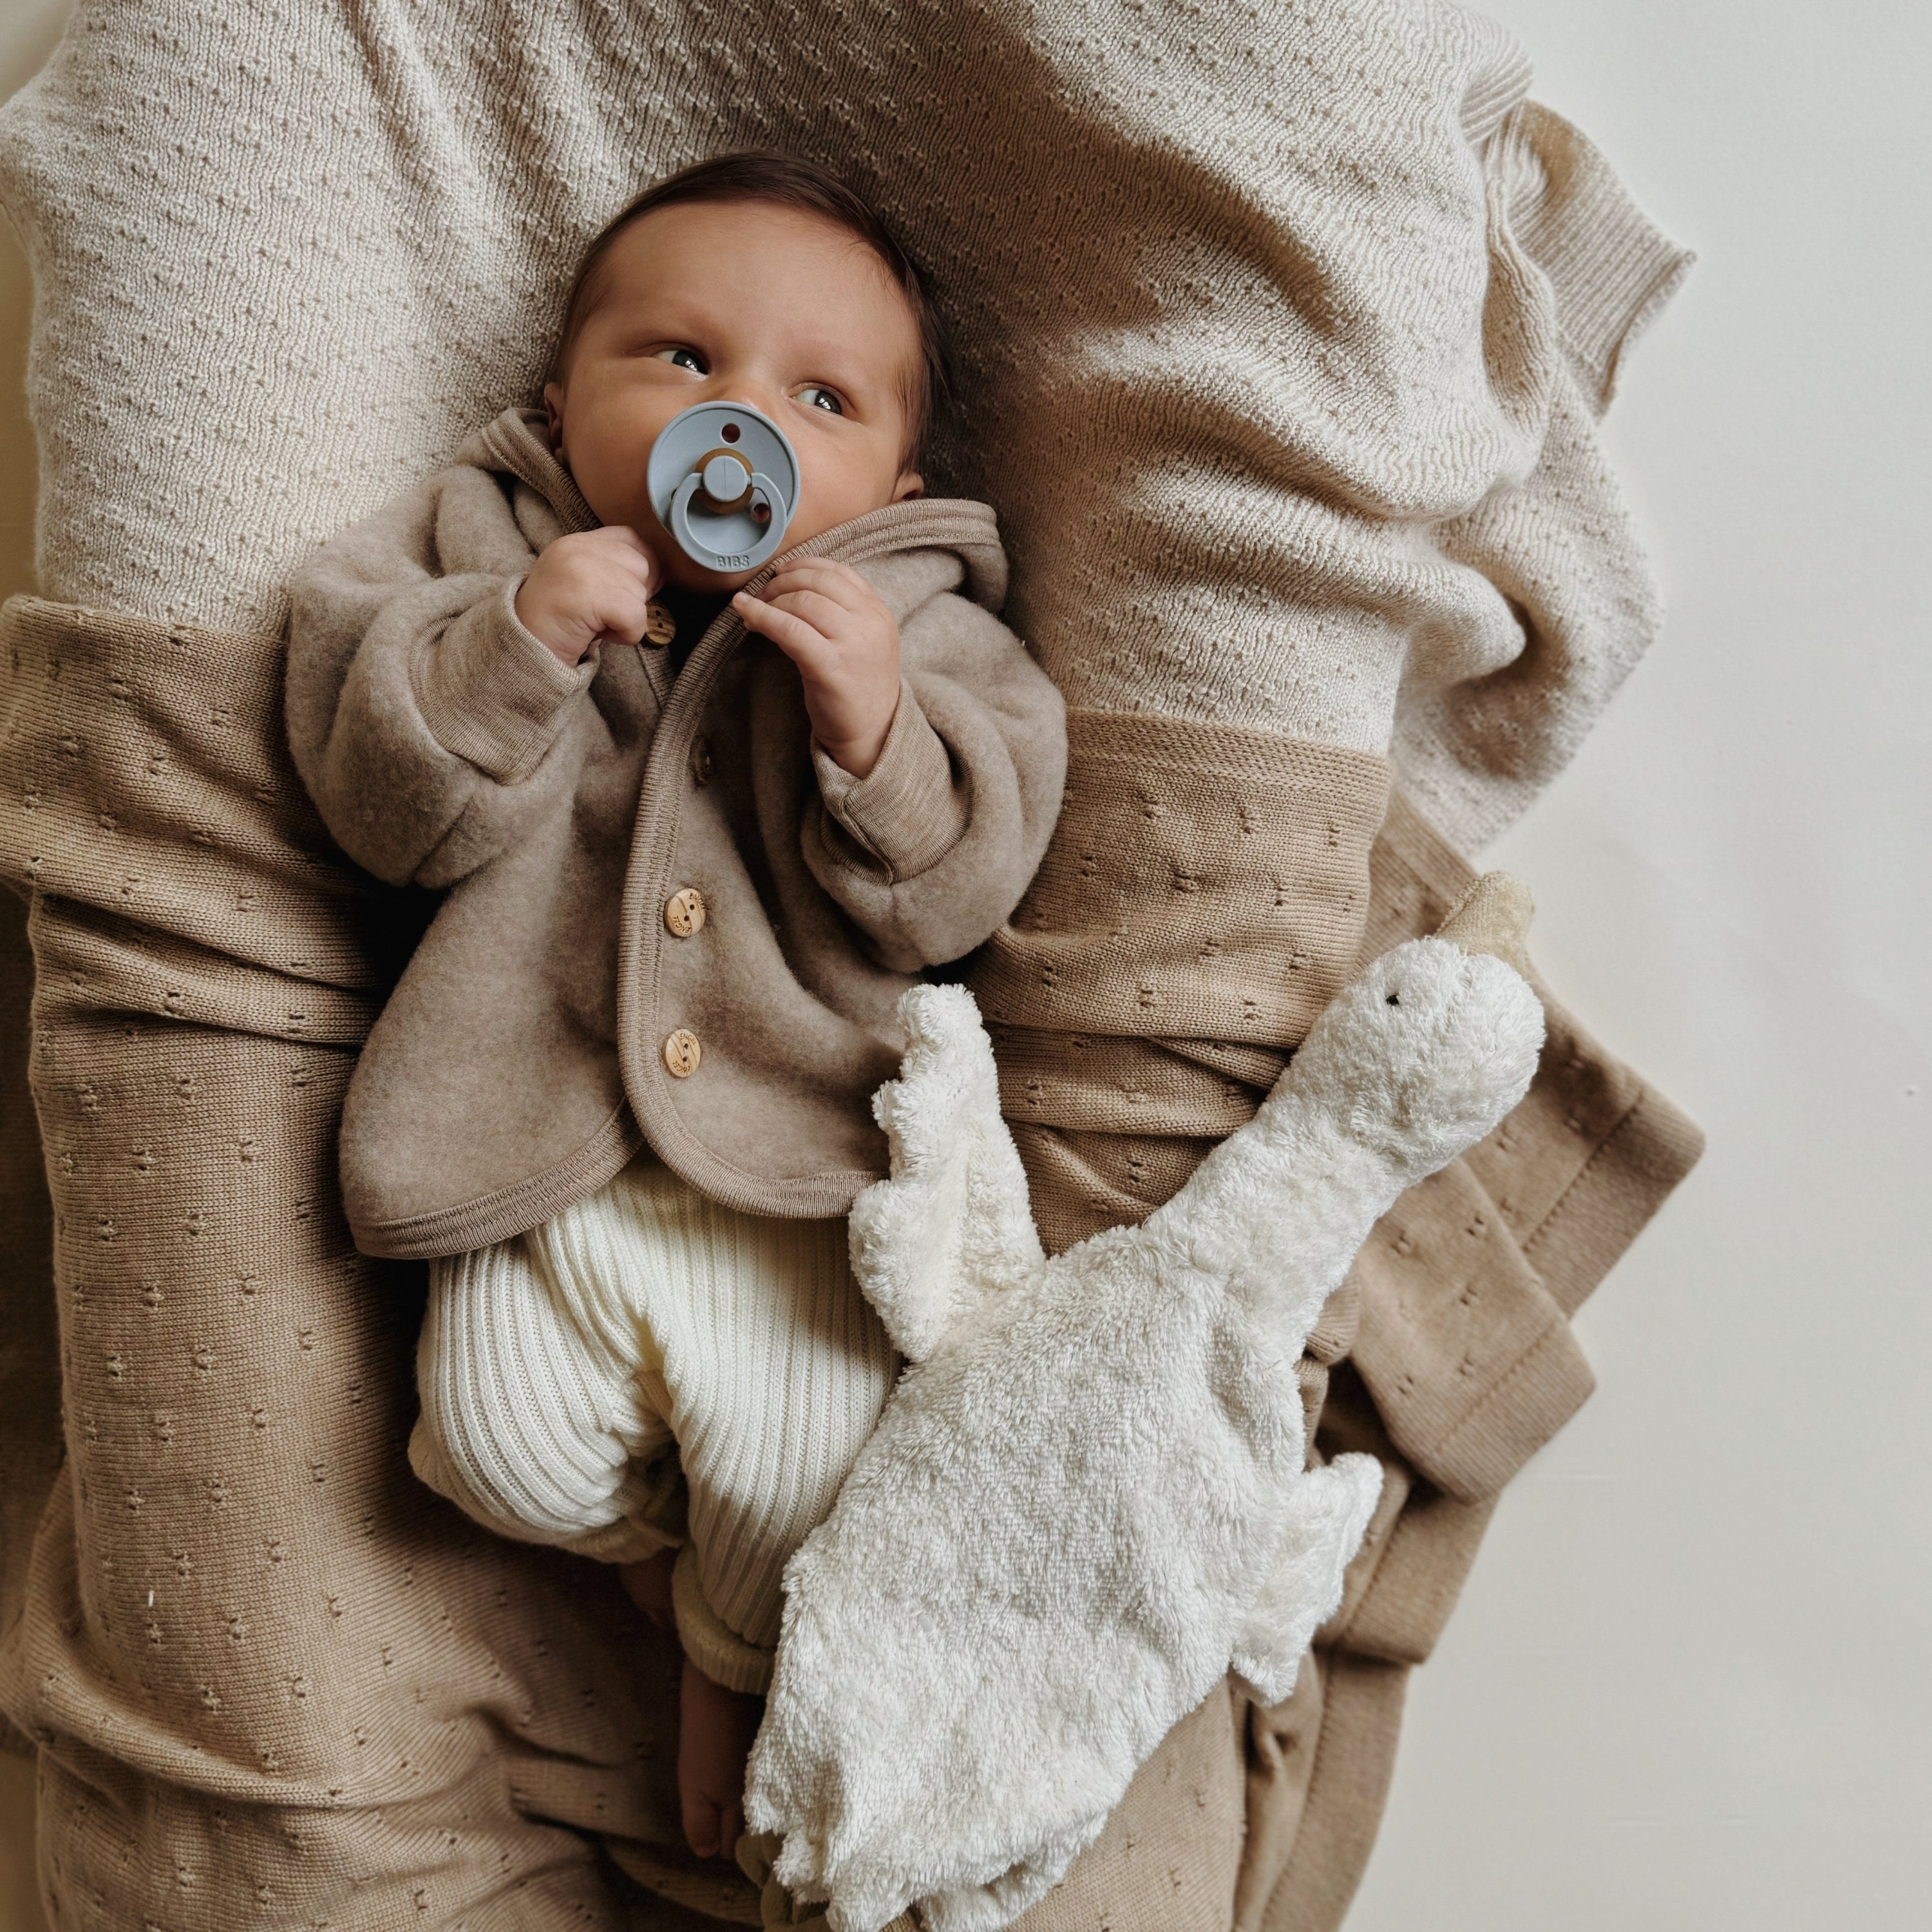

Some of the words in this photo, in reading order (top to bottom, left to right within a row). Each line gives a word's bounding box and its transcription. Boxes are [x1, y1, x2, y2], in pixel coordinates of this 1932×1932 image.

[716, 554, 750, 569] BIBS
[672, 915, 692, 933] ENGEL
[680, 1032, 696, 1046] ENGEL
